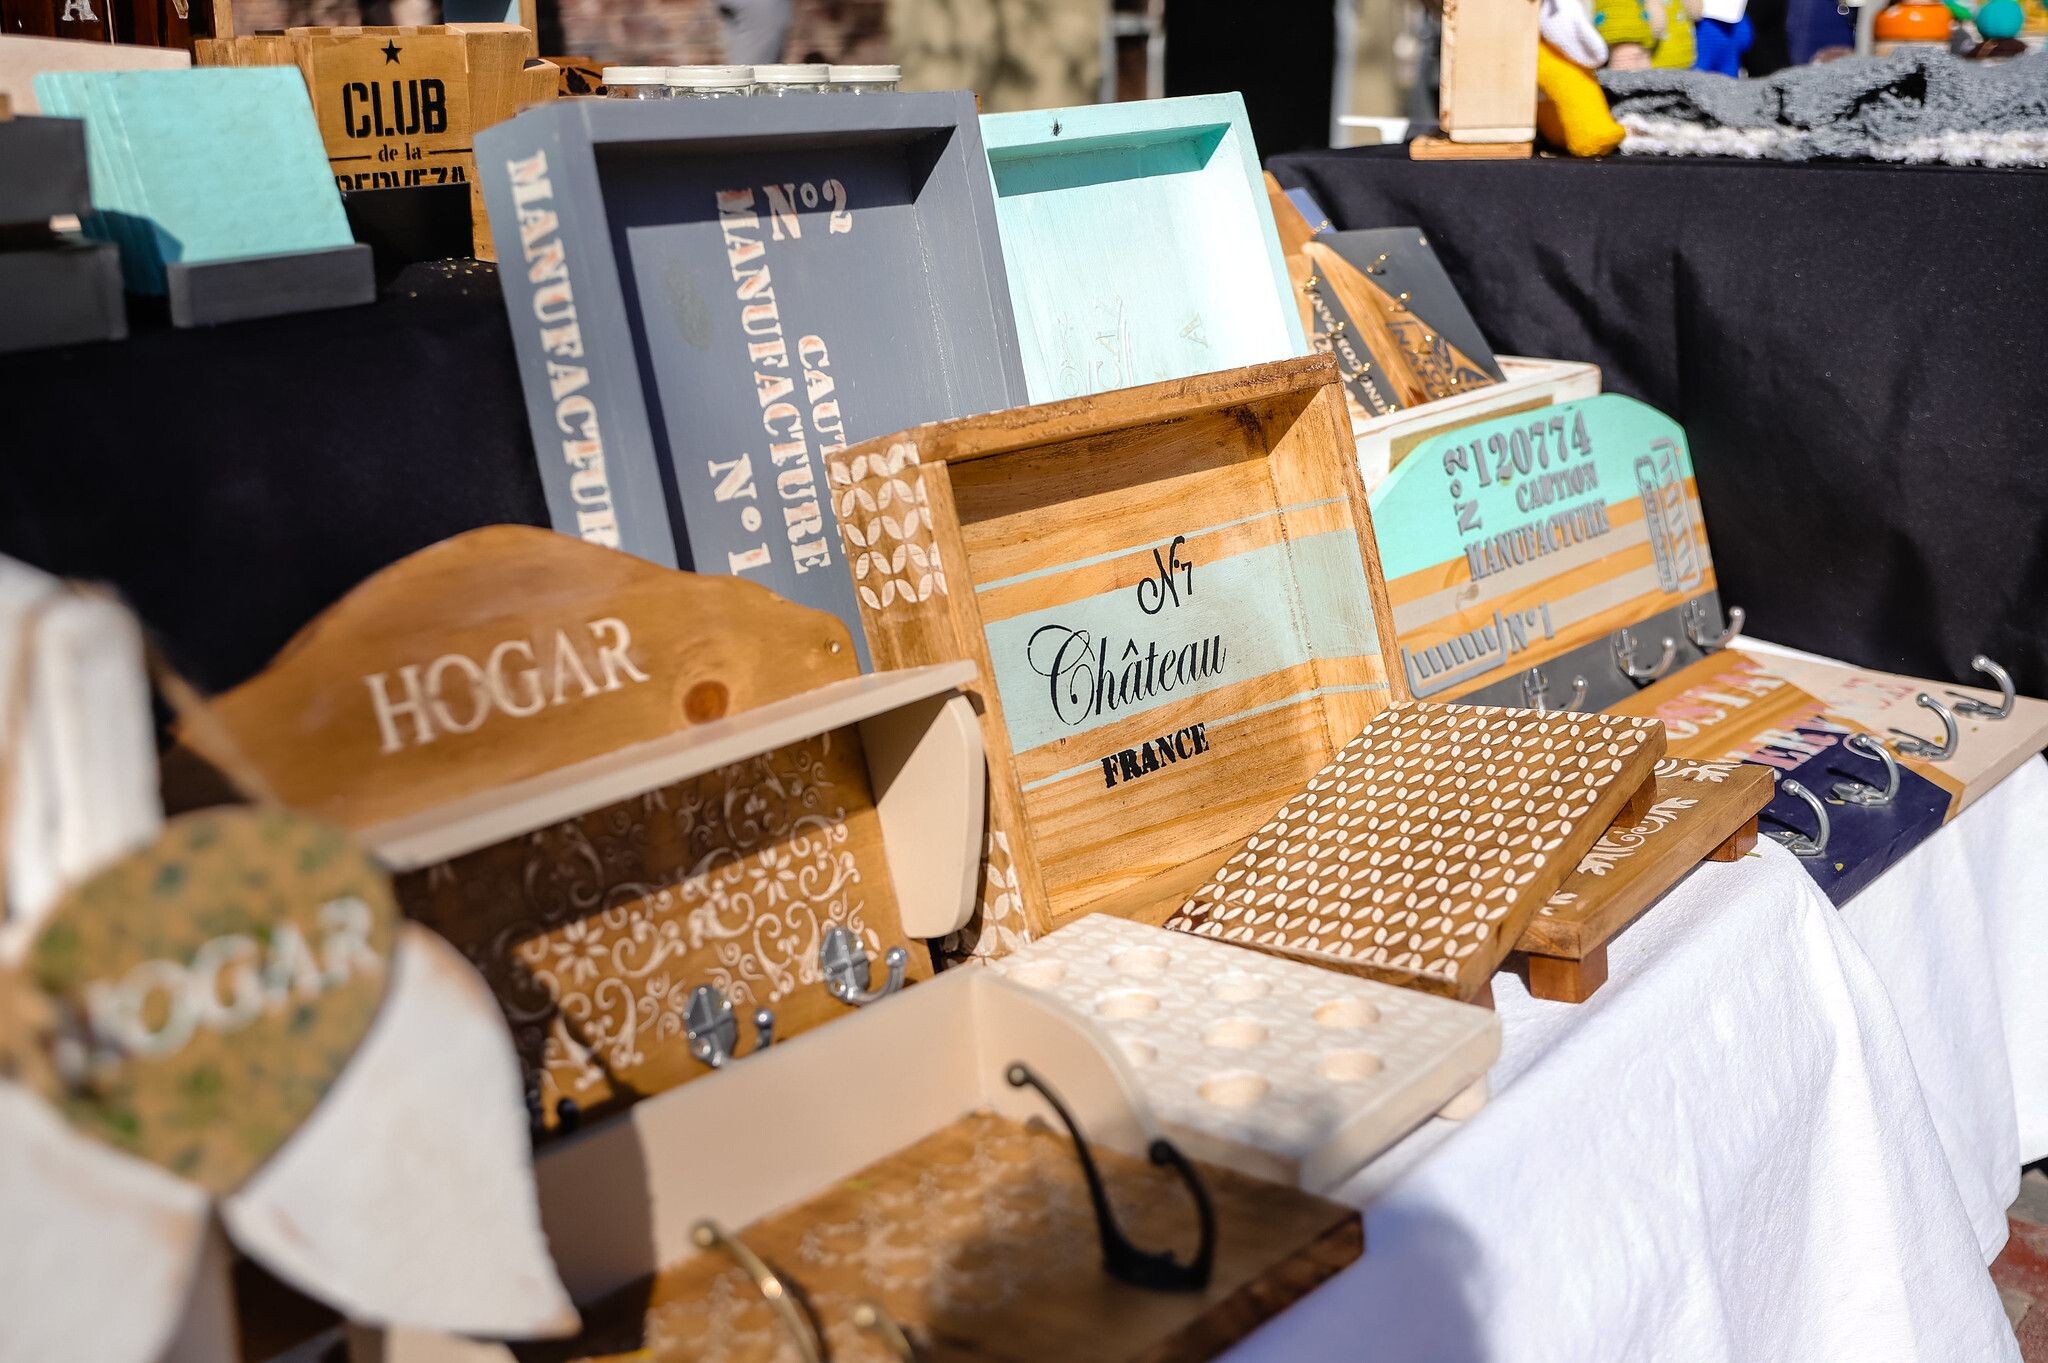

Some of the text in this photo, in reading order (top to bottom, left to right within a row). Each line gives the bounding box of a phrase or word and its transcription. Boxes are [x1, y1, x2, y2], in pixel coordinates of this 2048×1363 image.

[342, 78, 447, 138] CLUB
[378, 143, 422, 162] de la
[715, 188, 832, 575] MANUFACTURE
[1470, 409, 1593, 488] 120774
[1515, 461, 1599, 513] CAUTION
[363, 617, 650, 753] HOGAR
[1027, 624, 1227, 726] Château
[1100, 722, 1210, 789] FRANCE
